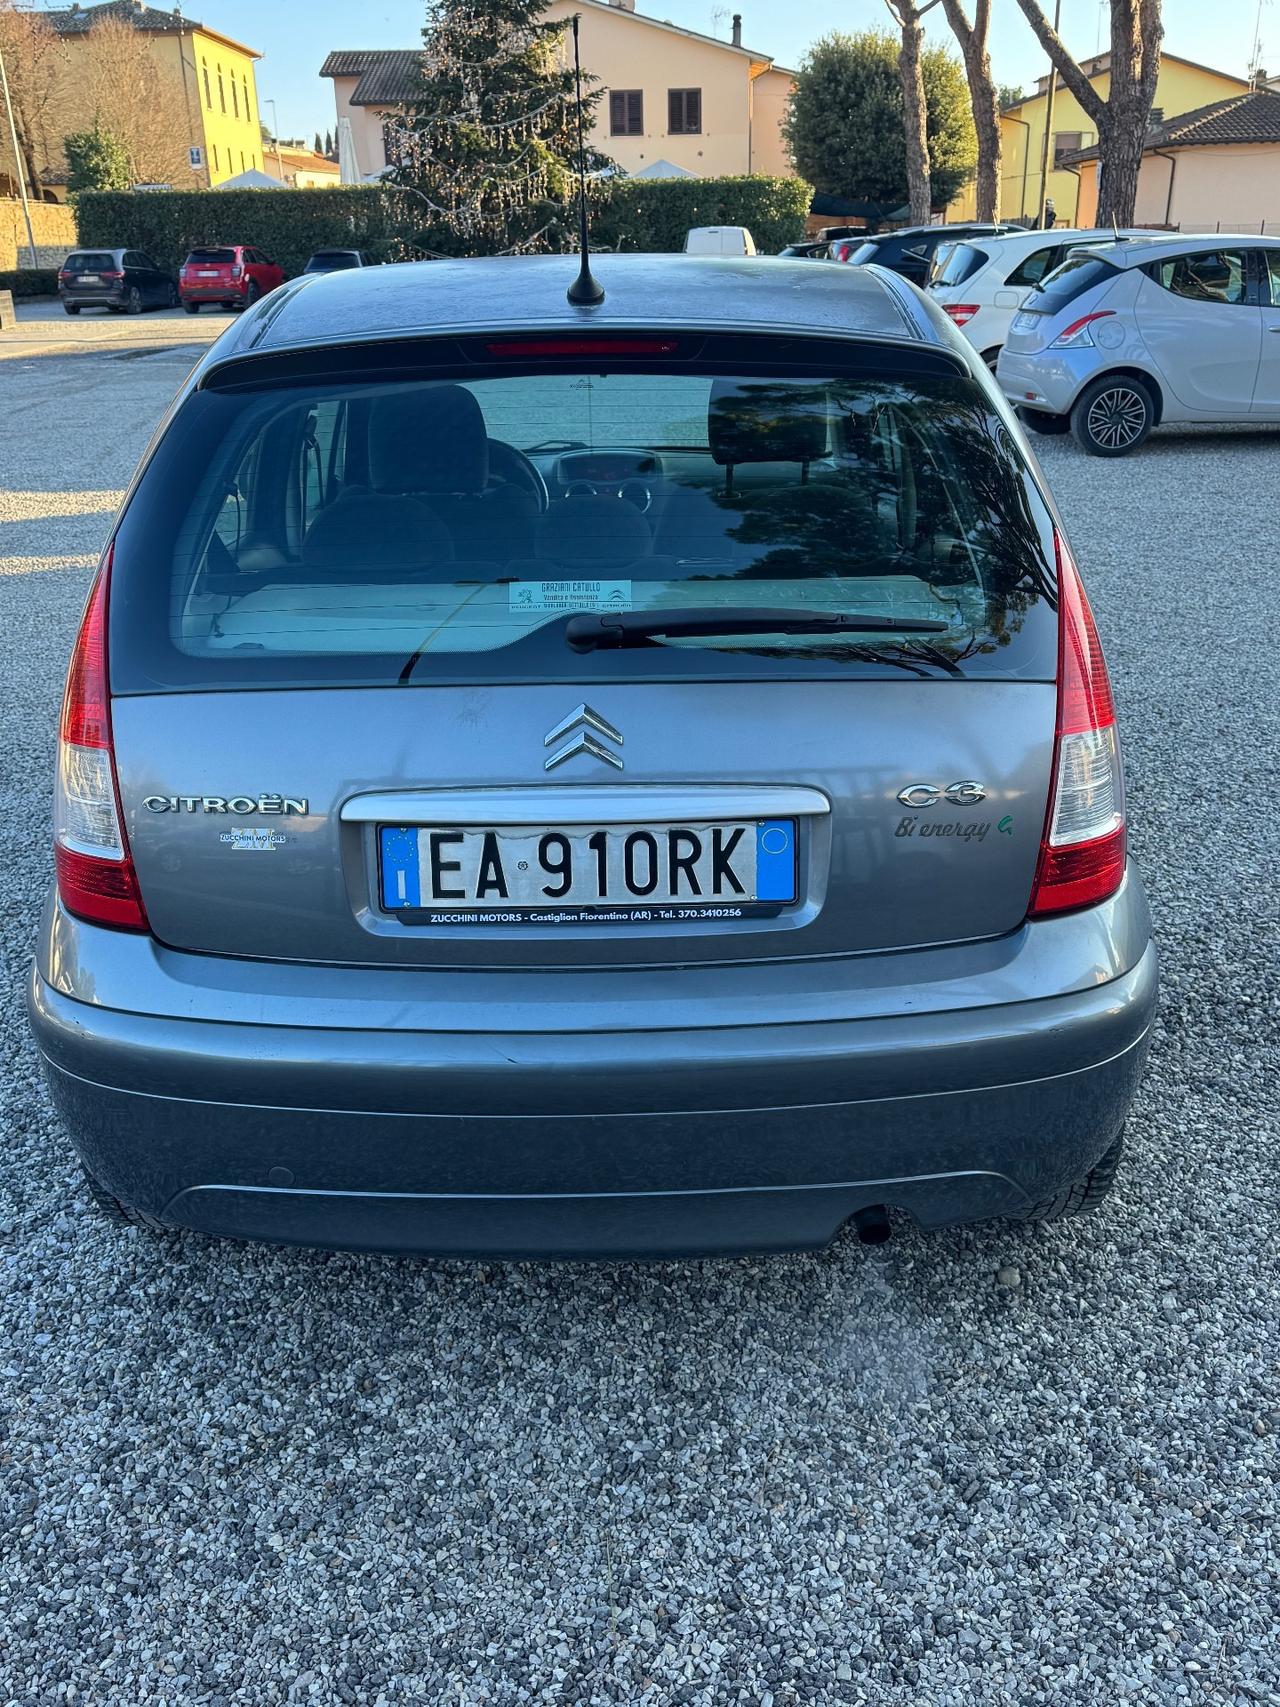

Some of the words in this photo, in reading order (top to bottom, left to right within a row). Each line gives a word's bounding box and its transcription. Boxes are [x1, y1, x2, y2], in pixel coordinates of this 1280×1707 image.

[542, 582, 571, 592] GRAZIANI
[573, 582, 600, 592] CATULLO
[141, 793, 309, 814] CITROËN
[897, 781, 987, 808] C3
[220, 834, 255, 842] ZUCCHINI
[894, 815, 918, 837] Bi
[919, 822, 991, 842] energy
[430, 832, 510, 899] EA
[538, 829, 746, 898] 910RK
[430, 914, 478, 923] ZUCCHINI
[480, 913, 522, 922] MOTORS
[530, 913, 578, 922] Castiglion
[579, 912, 628, 920] Fiorentino
[630, 911, 652, 920] (AR)
[659, 910, 676, 919] Tel.
[678, 908, 742, 918] 370.3410256
